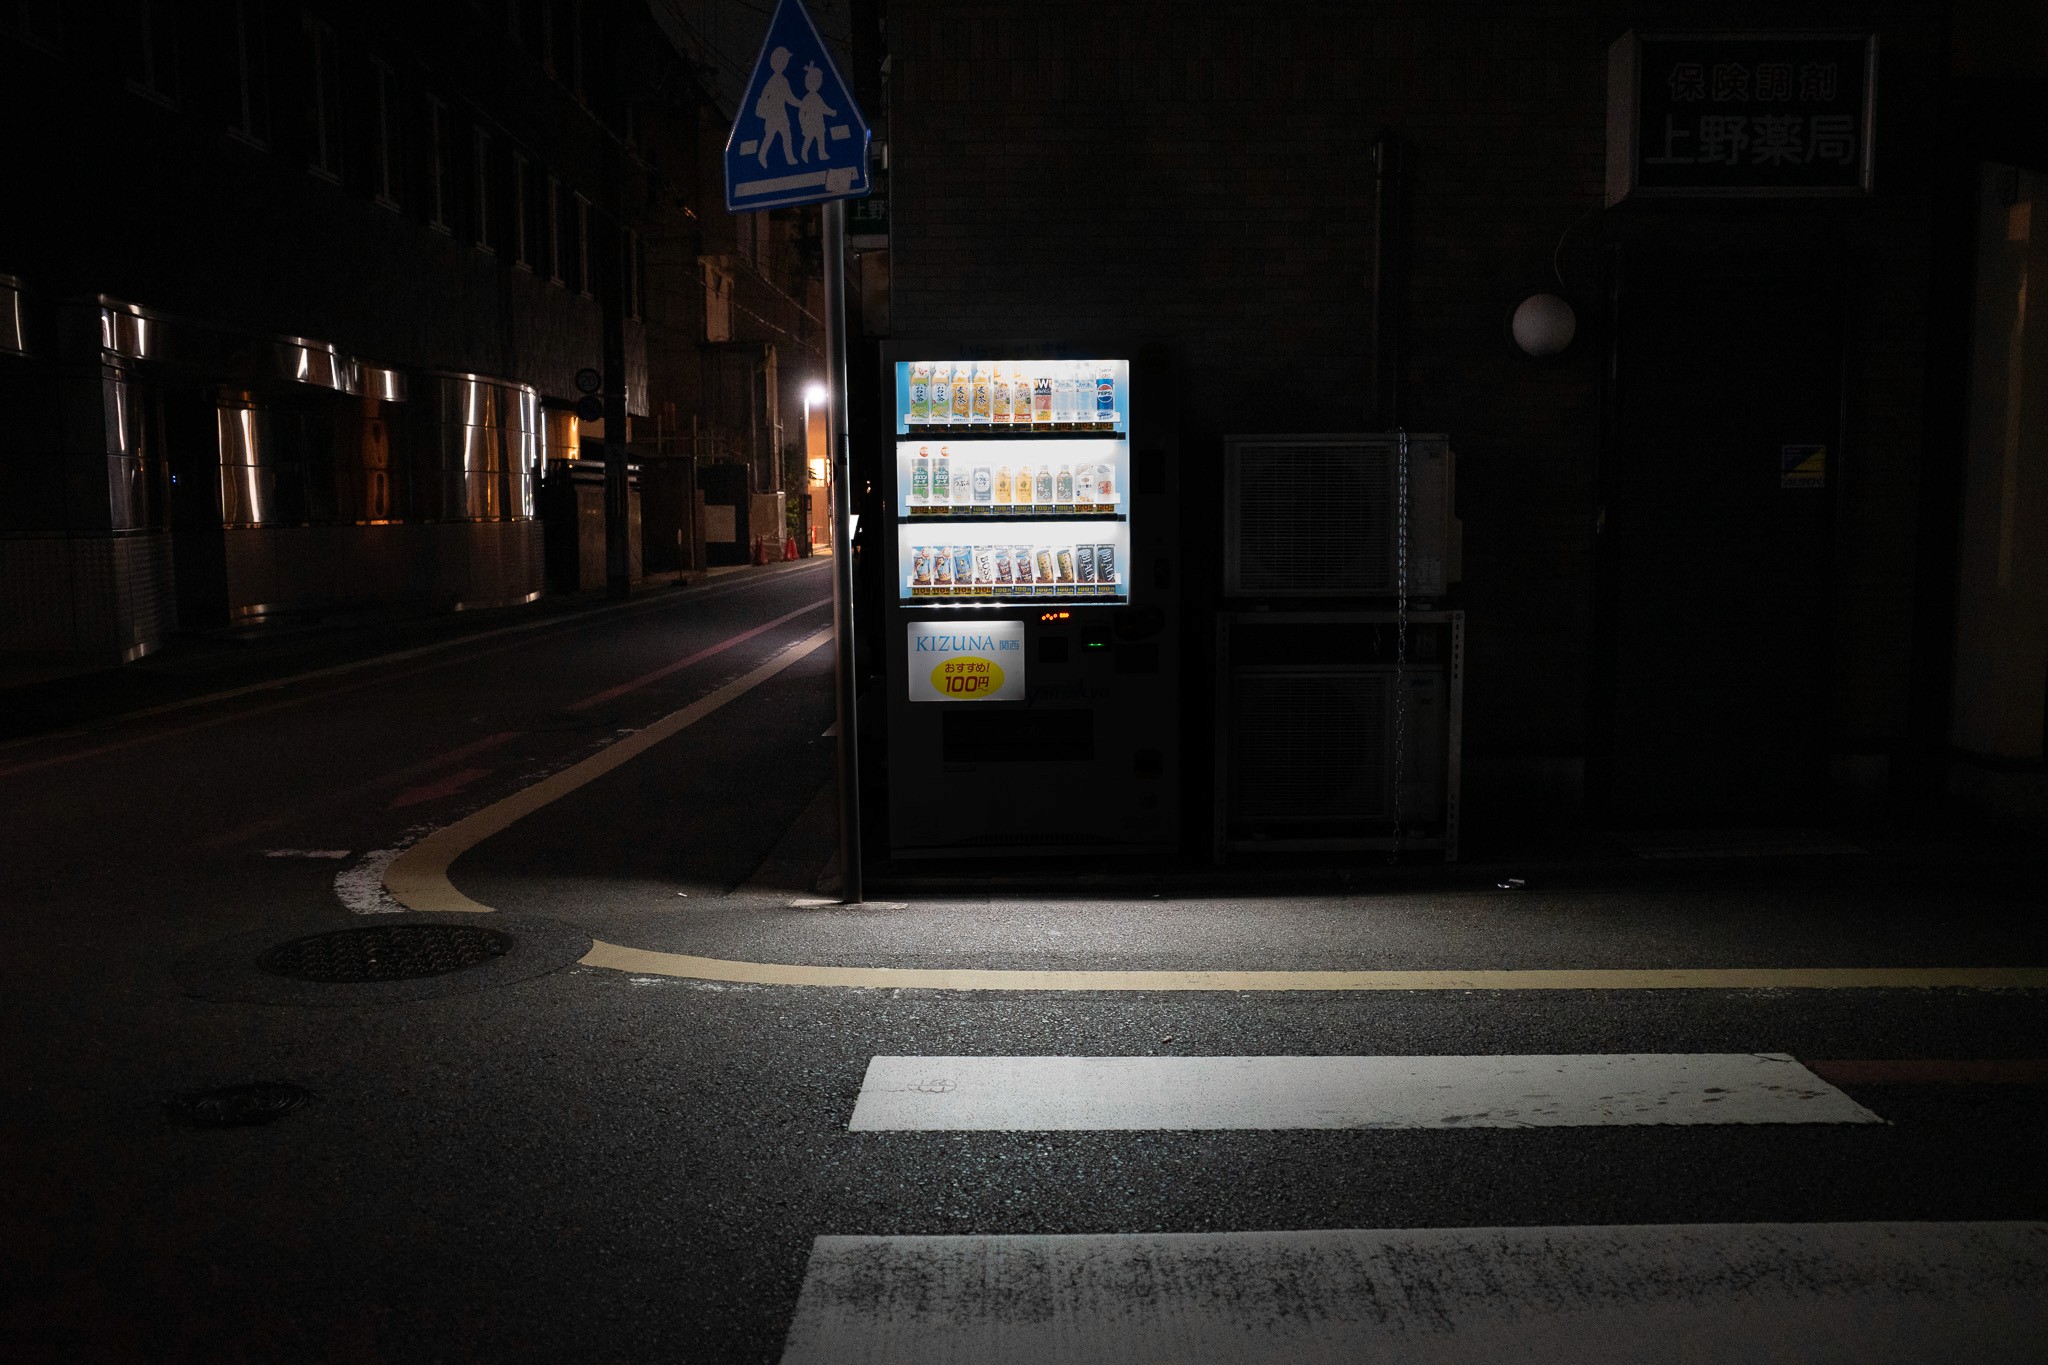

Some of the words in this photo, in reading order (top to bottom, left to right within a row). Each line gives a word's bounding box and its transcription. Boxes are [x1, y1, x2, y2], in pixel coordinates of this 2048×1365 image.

[1668, 62, 1837, 101] 保険調剤
[1644, 113, 1856, 166] 上野薬局
[980, 555, 992, 581] BOSS
[1081, 553, 1095, 582] BLACK
[1102, 552, 1115, 581] BLACK
[916, 635, 996, 652] KIZUNA
[999, 640, 1020, 651] 関西
[945, 663, 990, 673] おすすめ!
